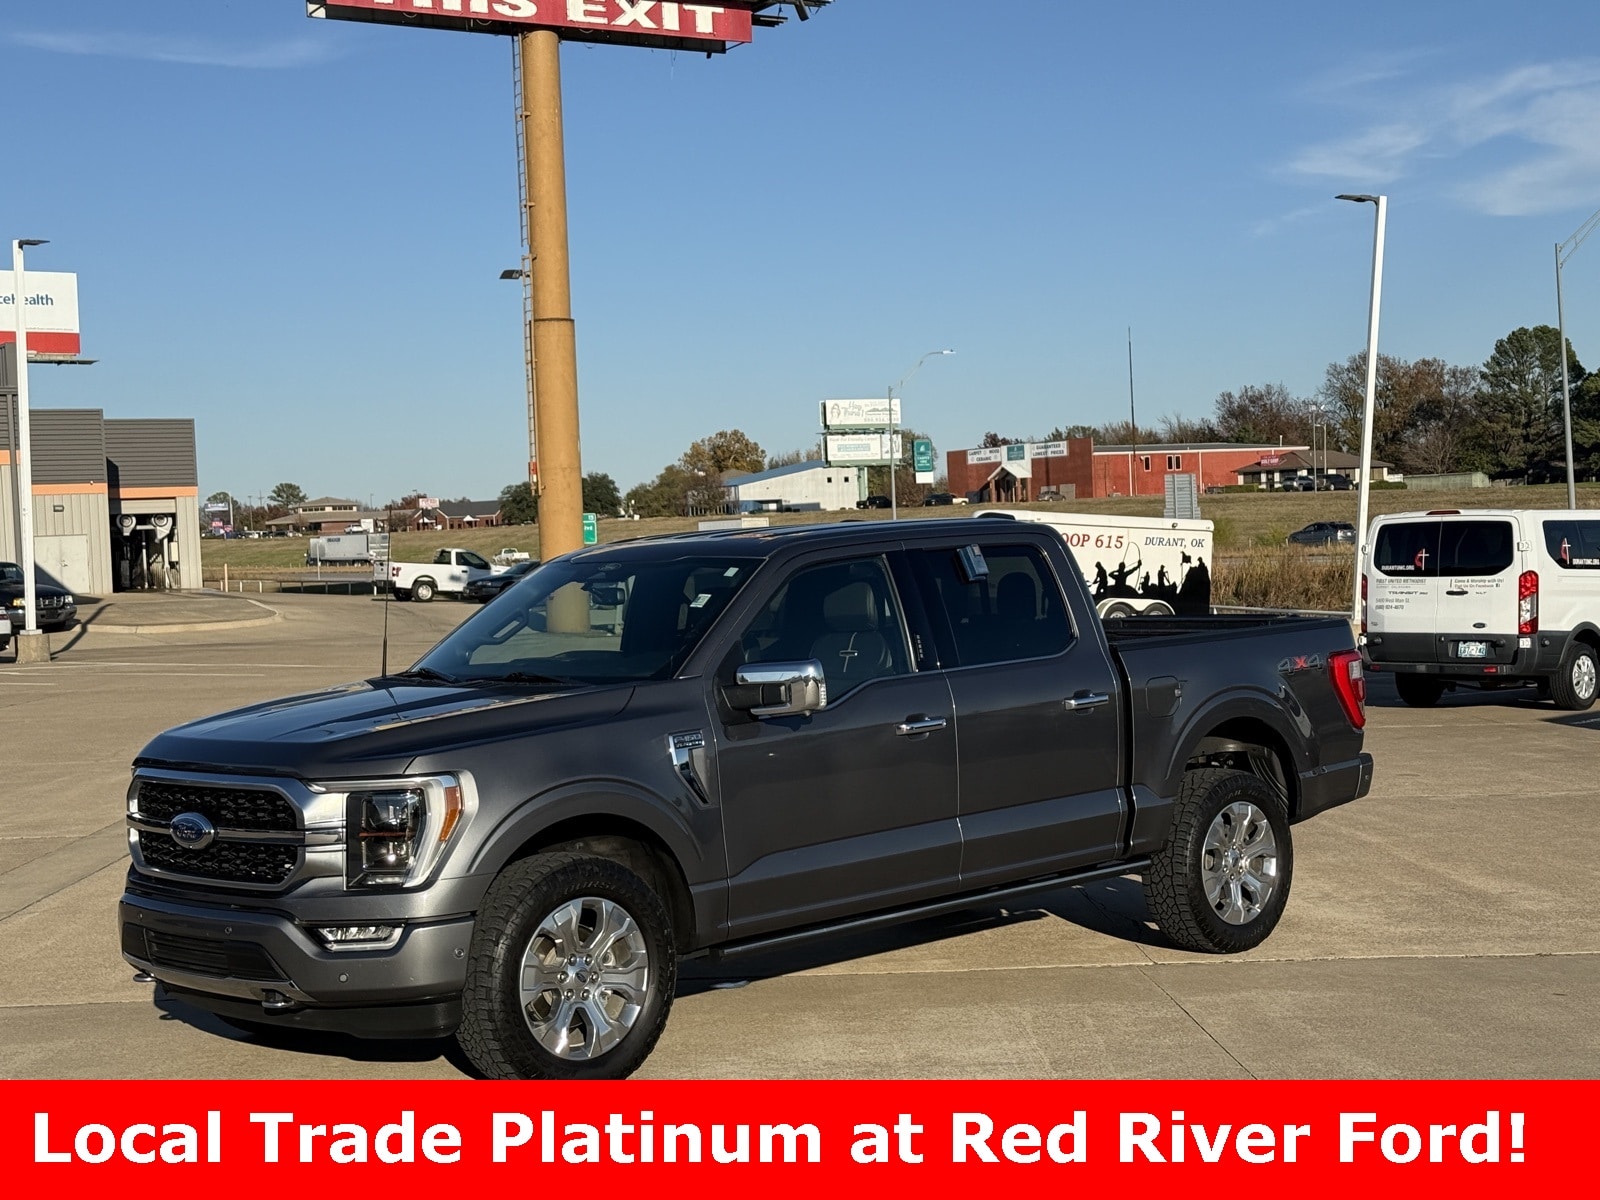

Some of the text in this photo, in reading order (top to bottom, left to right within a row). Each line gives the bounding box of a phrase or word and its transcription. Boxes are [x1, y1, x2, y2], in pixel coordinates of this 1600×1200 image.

[566, 0, 724, 33] EXIT
[1095, 534, 1124, 549] 615
[1144, 536, 1206, 549] DURANT, OK
